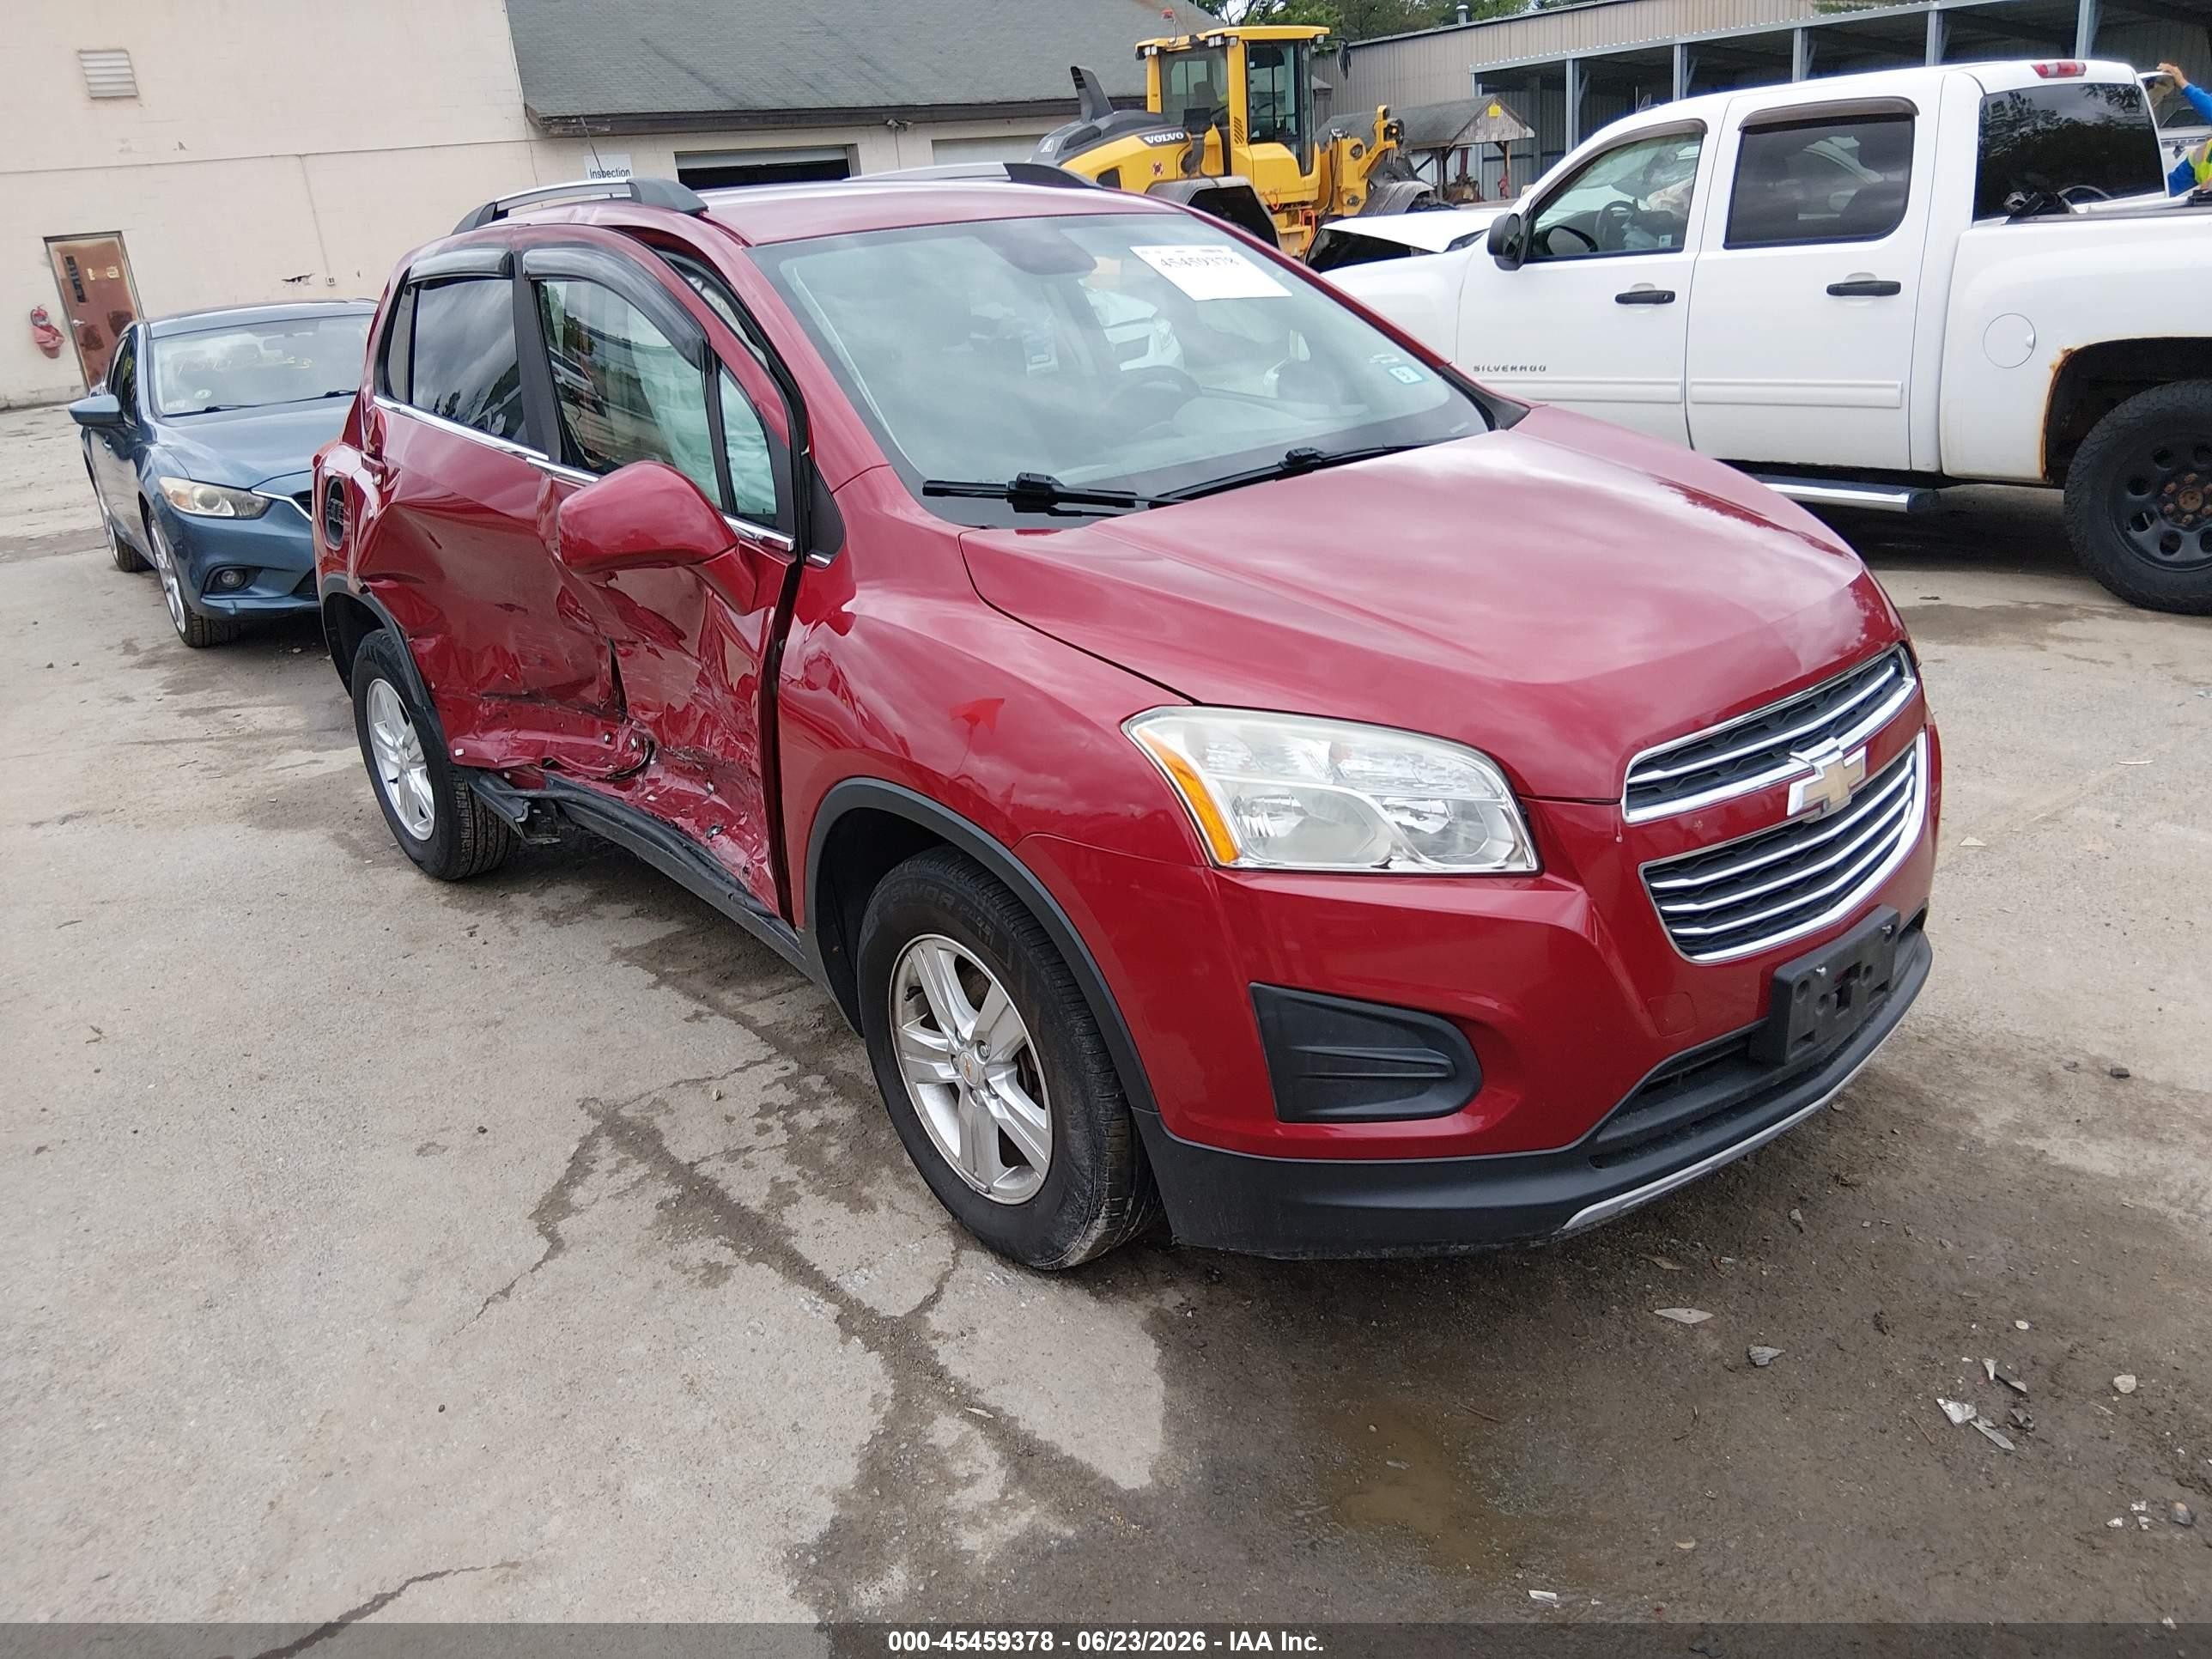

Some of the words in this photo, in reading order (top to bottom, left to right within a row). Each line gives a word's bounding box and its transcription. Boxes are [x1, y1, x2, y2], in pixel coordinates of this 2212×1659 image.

[1144, 131, 1184, 144] VOLVO
[589, 167, 631, 179] Inspection
[1473, 364, 1547, 373] SILVERADO
